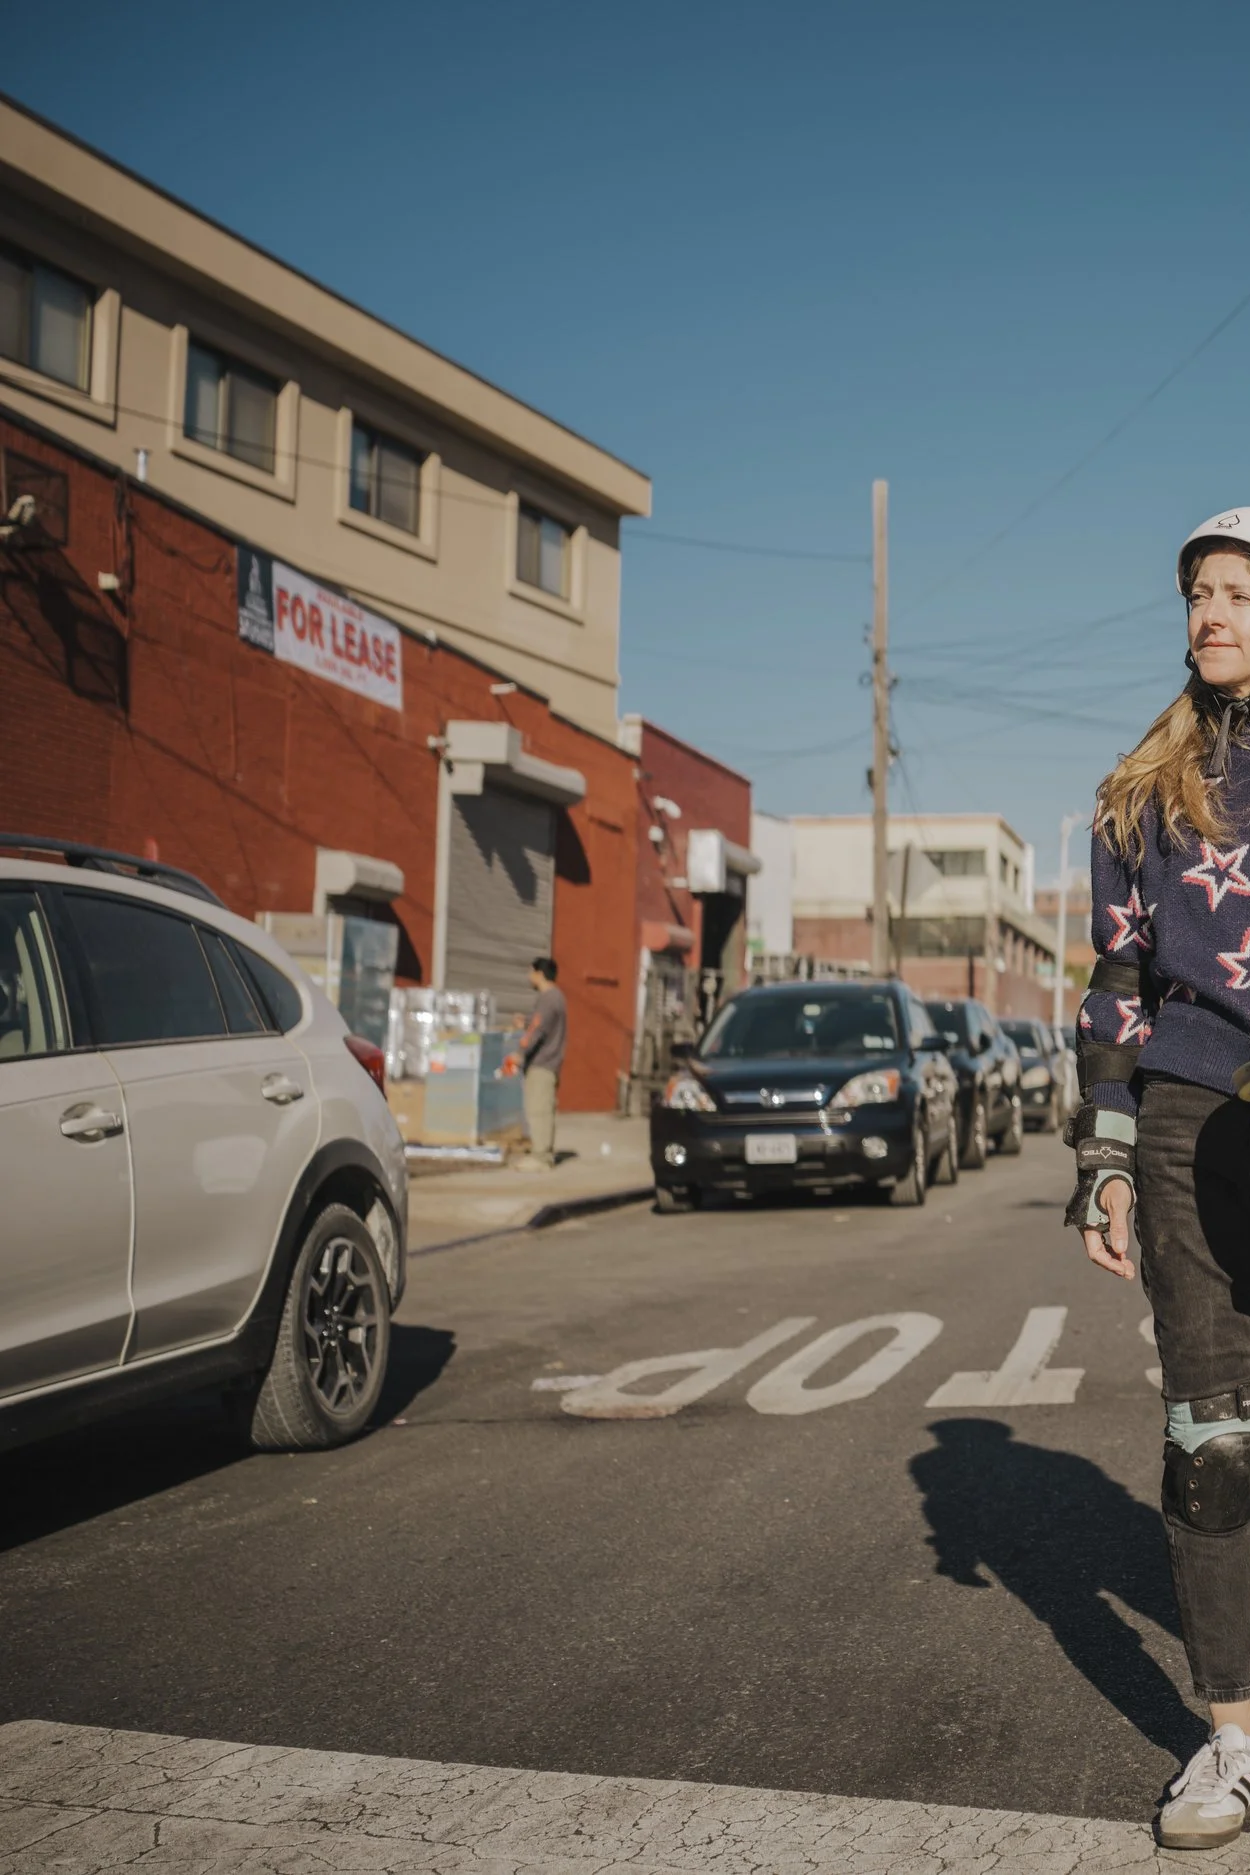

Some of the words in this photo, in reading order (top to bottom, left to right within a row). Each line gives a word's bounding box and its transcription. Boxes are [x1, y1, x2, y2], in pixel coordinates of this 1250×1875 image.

[276, 588, 325, 651] FOR
[331, 614, 396, 684] LEASE
[1111, 1150, 1128, 1159] PRO
